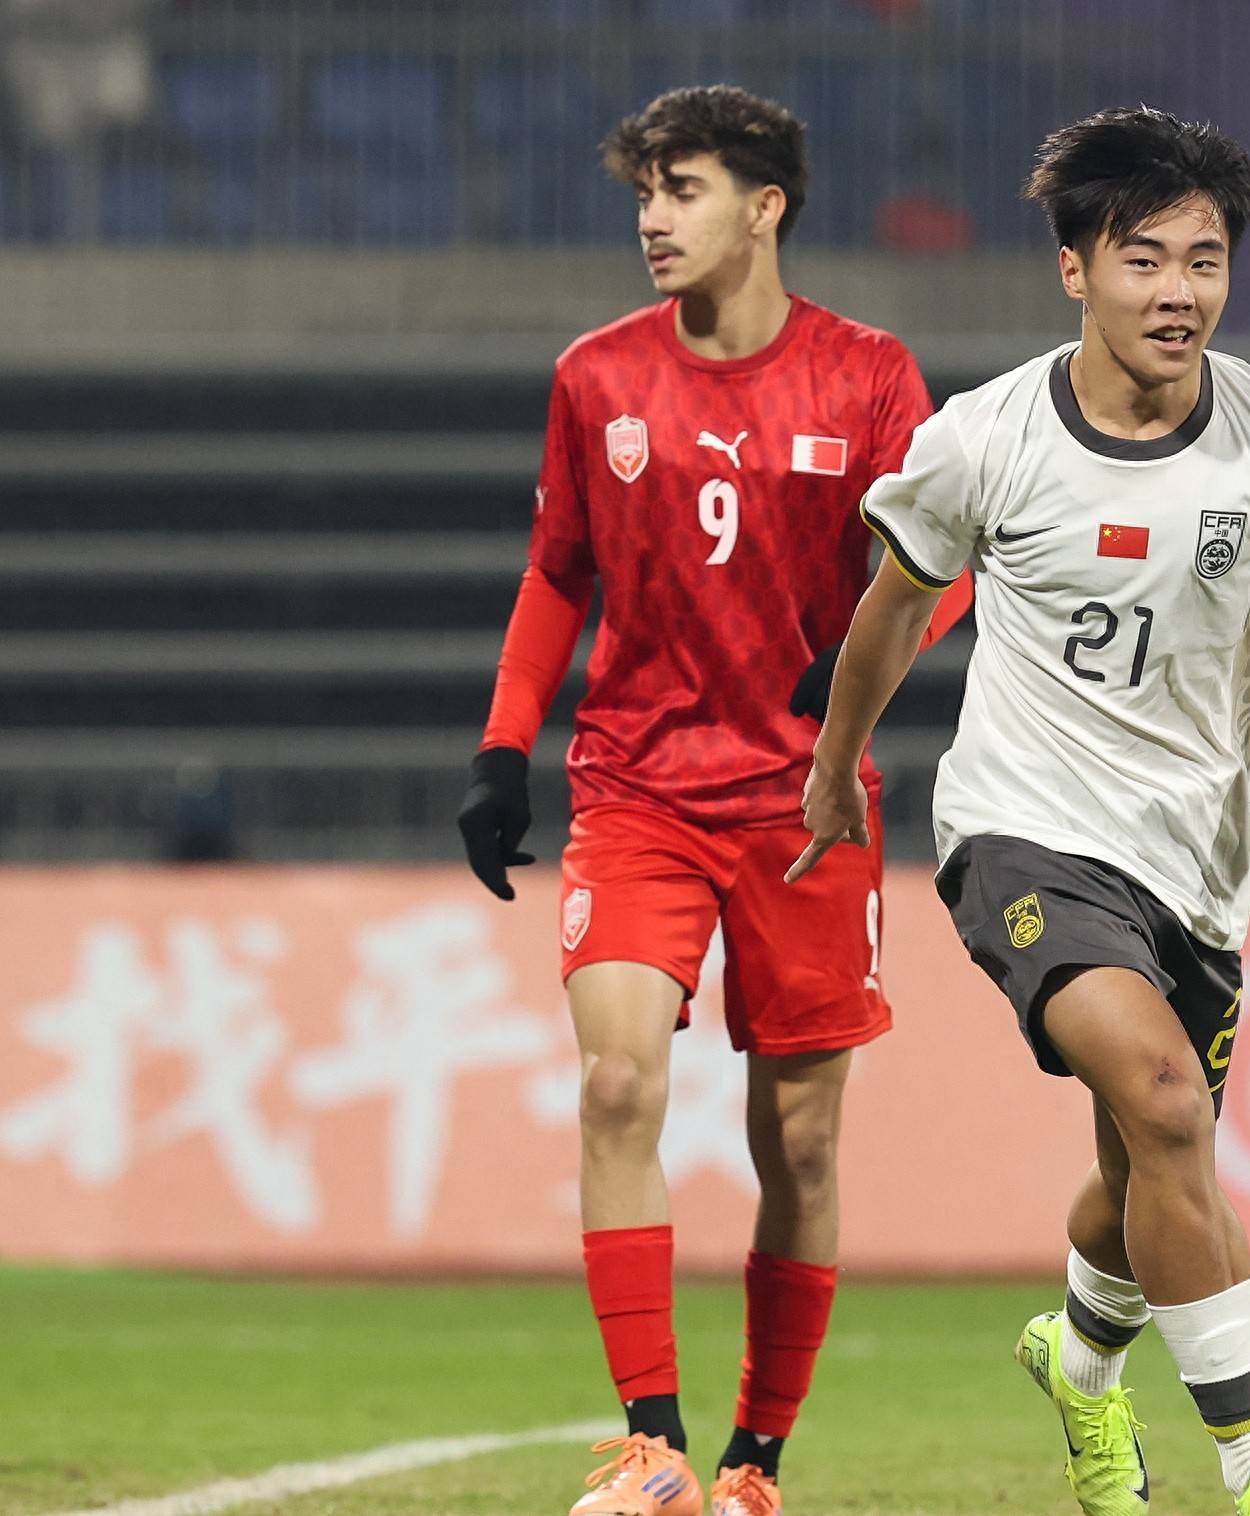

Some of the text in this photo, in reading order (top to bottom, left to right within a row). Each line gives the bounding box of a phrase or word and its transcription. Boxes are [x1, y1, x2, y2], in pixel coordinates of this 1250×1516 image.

[698, 478, 738, 566] 9
[1204, 515, 1242, 529] CFA
[1063, 601, 1154, 687] 21
